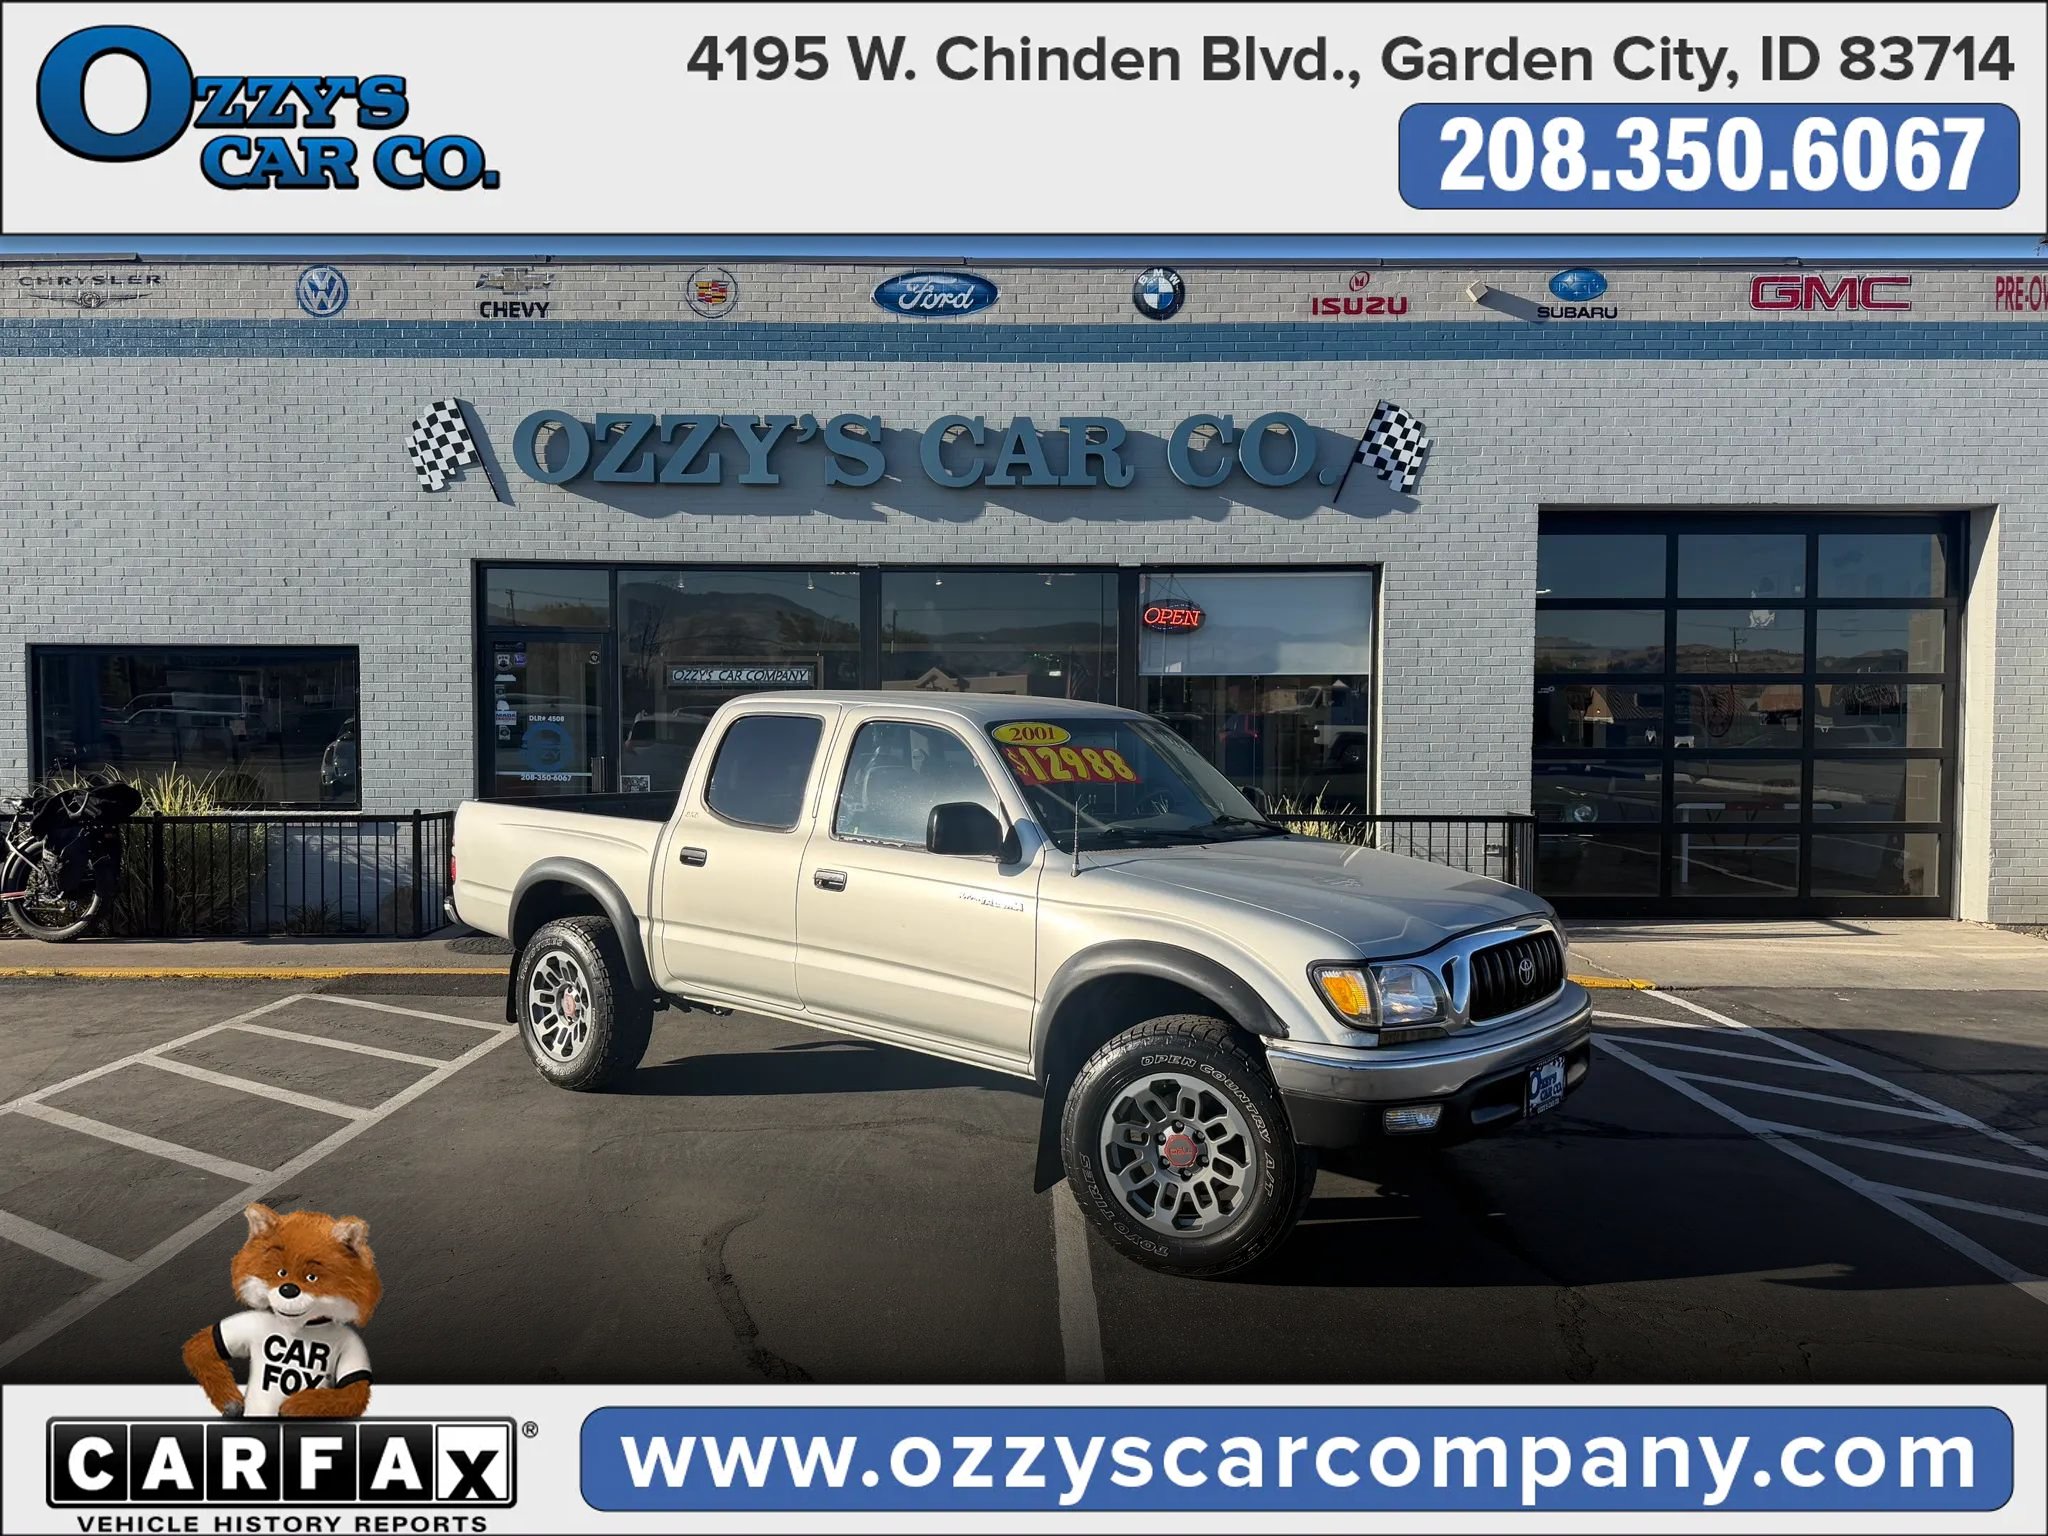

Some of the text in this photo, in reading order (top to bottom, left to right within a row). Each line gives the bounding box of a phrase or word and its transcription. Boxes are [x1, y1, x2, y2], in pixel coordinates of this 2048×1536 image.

[18, 274, 162, 287] CHRYSLER
[1138, 268, 1181, 285] BMW
[898, 280, 976, 310] Ford
[1750, 274, 1911, 311] GMC
[479, 301, 550, 319] CHEVY
[1312, 296, 1408, 316] ISUZU
[1537, 306, 1618, 319] SUBARU
[513, 410, 1338, 488] OZZY'S CAR CO.
[1144, 607, 1201, 626] OPEN
[673, 669, 808, 682] OZZY'S CAR COMPANY
[1009, 727, 1056, 742] 2001
[1006, 746, 1137, 782] $12988
[520, 774, 572, 782] 208-350-6067
[1141, 1054, 1276, 1198] OPEN COUNTRY A/T
[1079, 1151, 1170, 1258] TOYO TIRES
